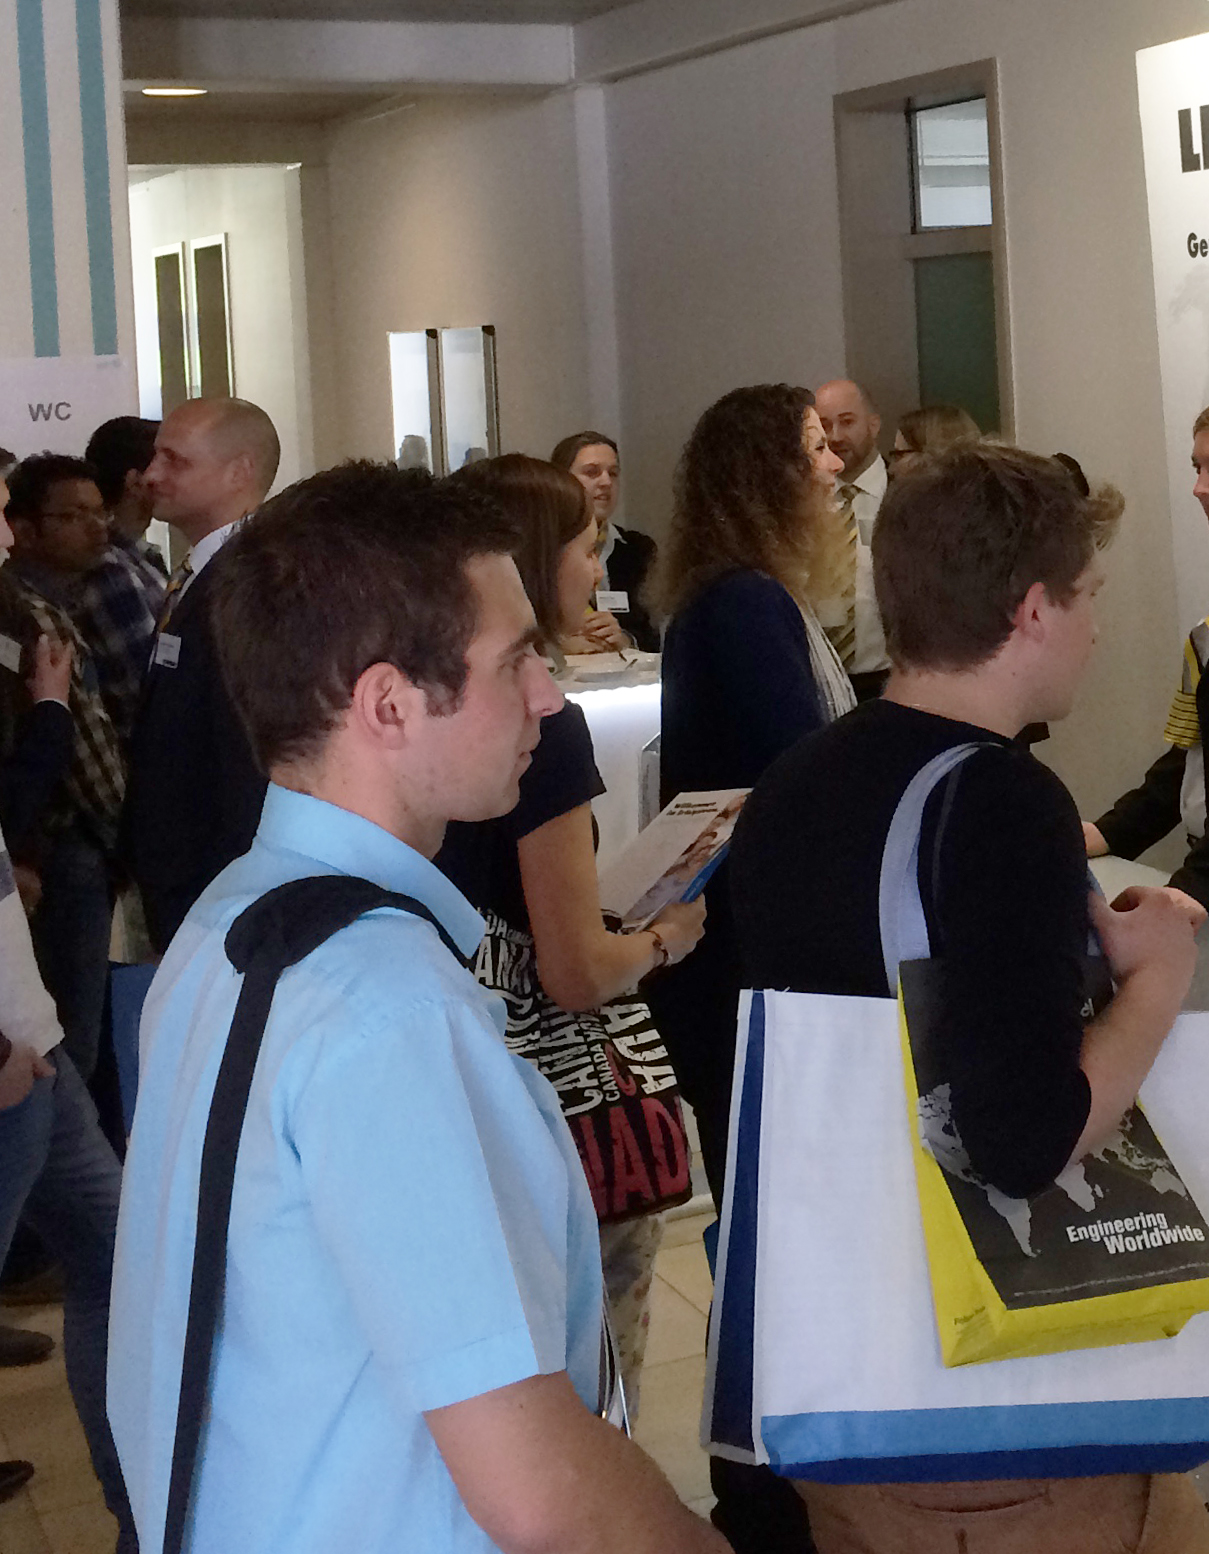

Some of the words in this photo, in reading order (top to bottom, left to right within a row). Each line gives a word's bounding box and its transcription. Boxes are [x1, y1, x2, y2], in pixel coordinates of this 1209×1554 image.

[28, 401, 72, 422] WC
[589, 1043, 621, 1102] CANADA
[1066, 1211, 1169, 1243] Engineering
[1104, 1225, 1205, 1255] Worldwide
